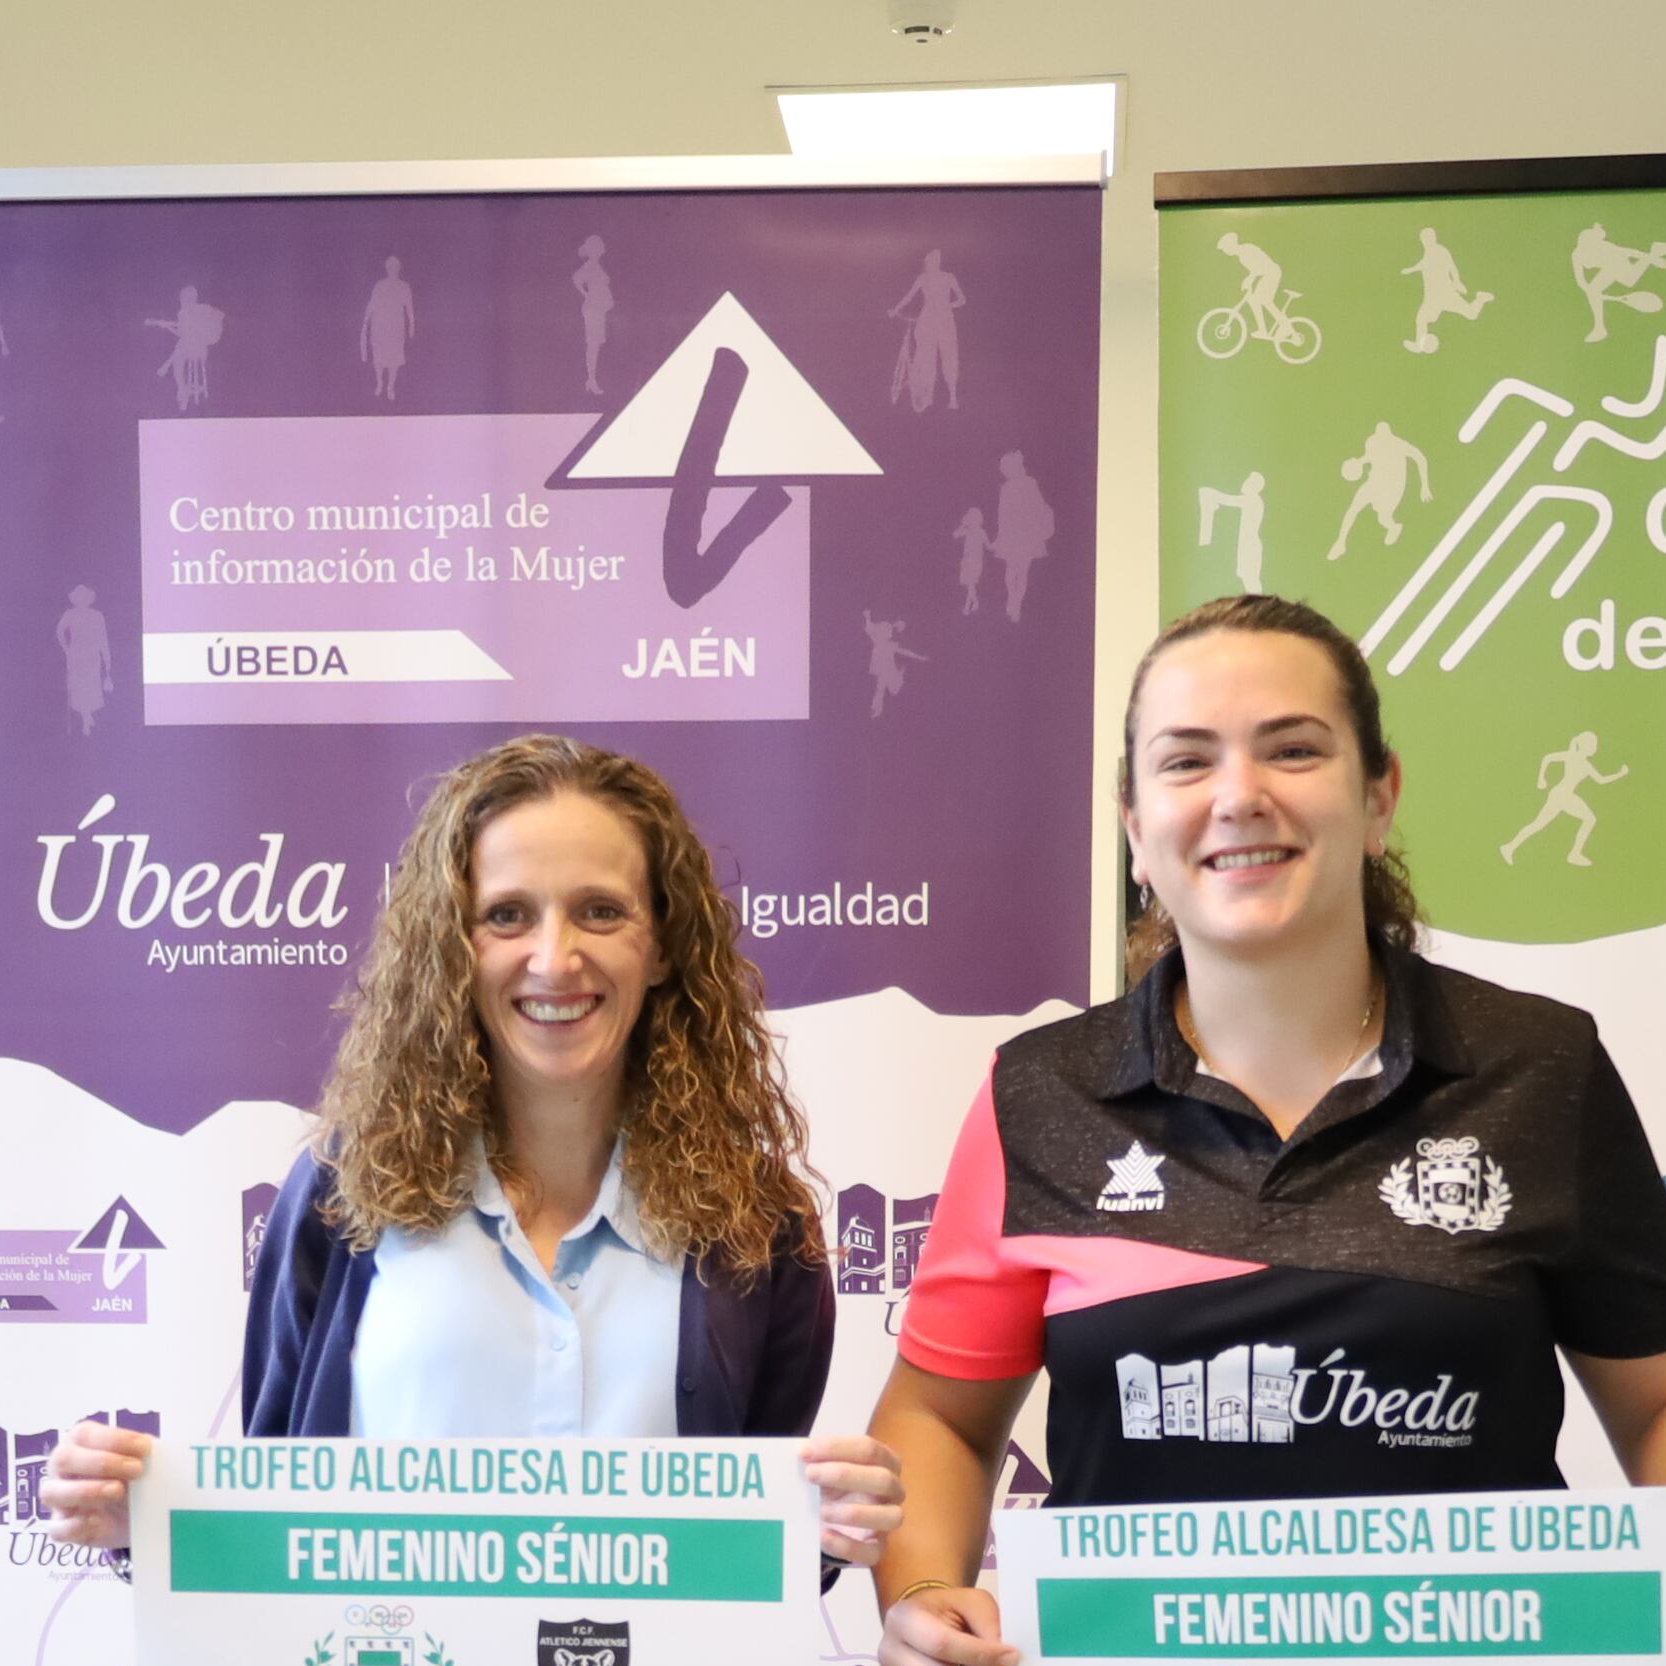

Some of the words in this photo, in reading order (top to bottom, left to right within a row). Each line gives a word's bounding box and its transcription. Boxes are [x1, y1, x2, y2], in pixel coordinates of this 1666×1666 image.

[169, 494, 295, 533] Centro
[307, 491, 492, 541] municipal
[504, 493, 550, 530] de
[170, 546, 395, 586] información
[409, 546, 456, 584] de
[466, 546, 500, 583] la
[510, 547, 625, 591] Mujer
[206, 635, 351, 676] ÚBEDA
[622, 628, 756, 678] JAÉN
[36, 794, 348, 930] Úbeda
[741, 882, 929, 939] Igualdad
[146, 938, 348, 969] Ayuntamiento
[1096, 1195, 1165, 1212] luanvi
[26, 1270, 40, 1281] de
[44, 1269, 54, 1281] la
[57, 1270, 93, 1284] Mujer
[55, 1253, 69, 1265] de
[92, 1295, 133, 1311] JAÉN
[1289, 1349, 1480, 1431] Úbeda
[1379, 1431, 1472, 1449] Ayuntamiento
[191, 1445, 334, 1492] TROFEO
[350, 1447, 567, 1496] ALCALDESA
[582, 1449, 627, 1496] DE
[287, 1526, 504, 1585] FEMENINO
[516, 1523, 668, 1586] SÉNIOR
[1054, 1512, 1199, 1558] TROFEO
[1212, 1506, 1435, 1556] ALCALDESA
[1449, 1507, 1495, 1553] DE
[1153, 1591, 1373, 1644] FEMENINO
[1384, 1581, 1541, 1641] SÉNIOR
